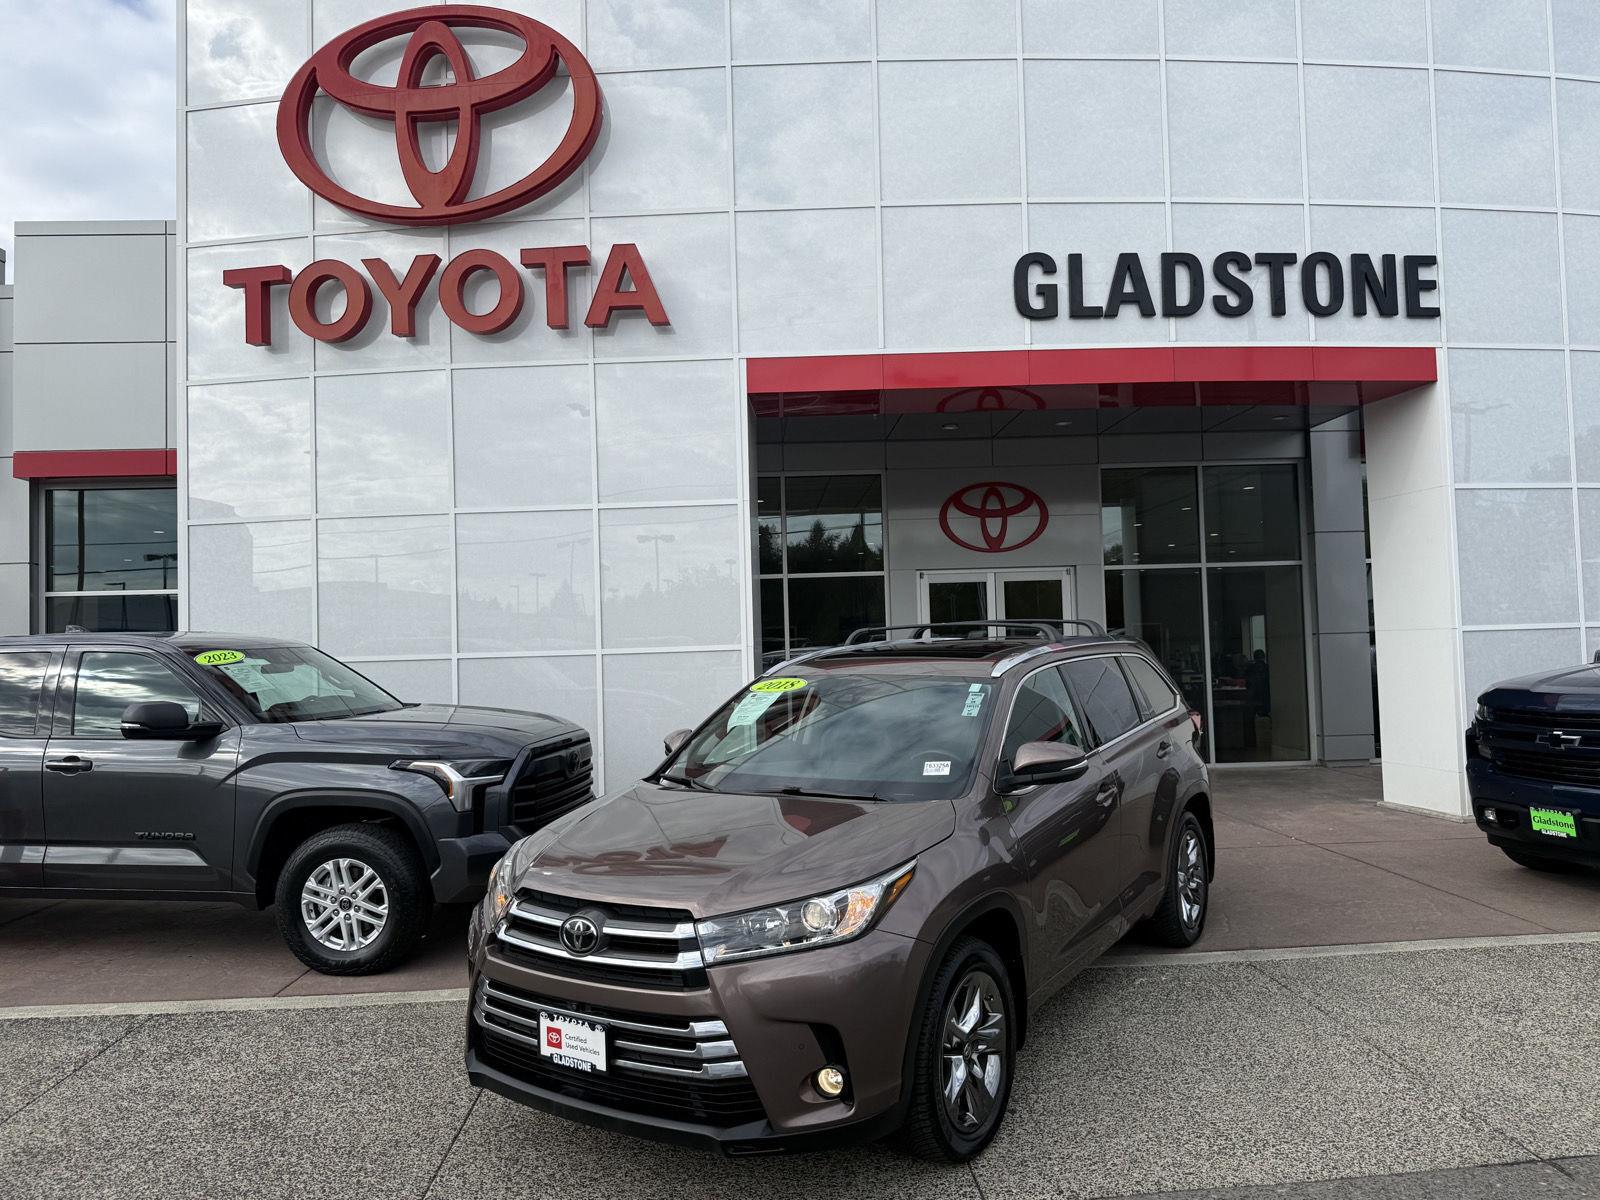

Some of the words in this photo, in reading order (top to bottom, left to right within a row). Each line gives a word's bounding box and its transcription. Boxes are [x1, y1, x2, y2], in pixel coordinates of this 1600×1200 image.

[1014, 251, 1440, 319] GLADSTONE
[223, 243, 671, 347] TOYOTA
[204, 652, 237, 664] 2023
[1532, 815, 1575, 829] Gladstone
[135, 831, 196, 840] TUNDRA
[553, 1014, 589, 1028] TOYOTA
[564, 1034, 587, 1044] Certified
[565, 1042, 579, 1050] Used
[579, 1046, 600, 1056] Vehicles
[553, 1053, 591, 1072] GLADSTONE
